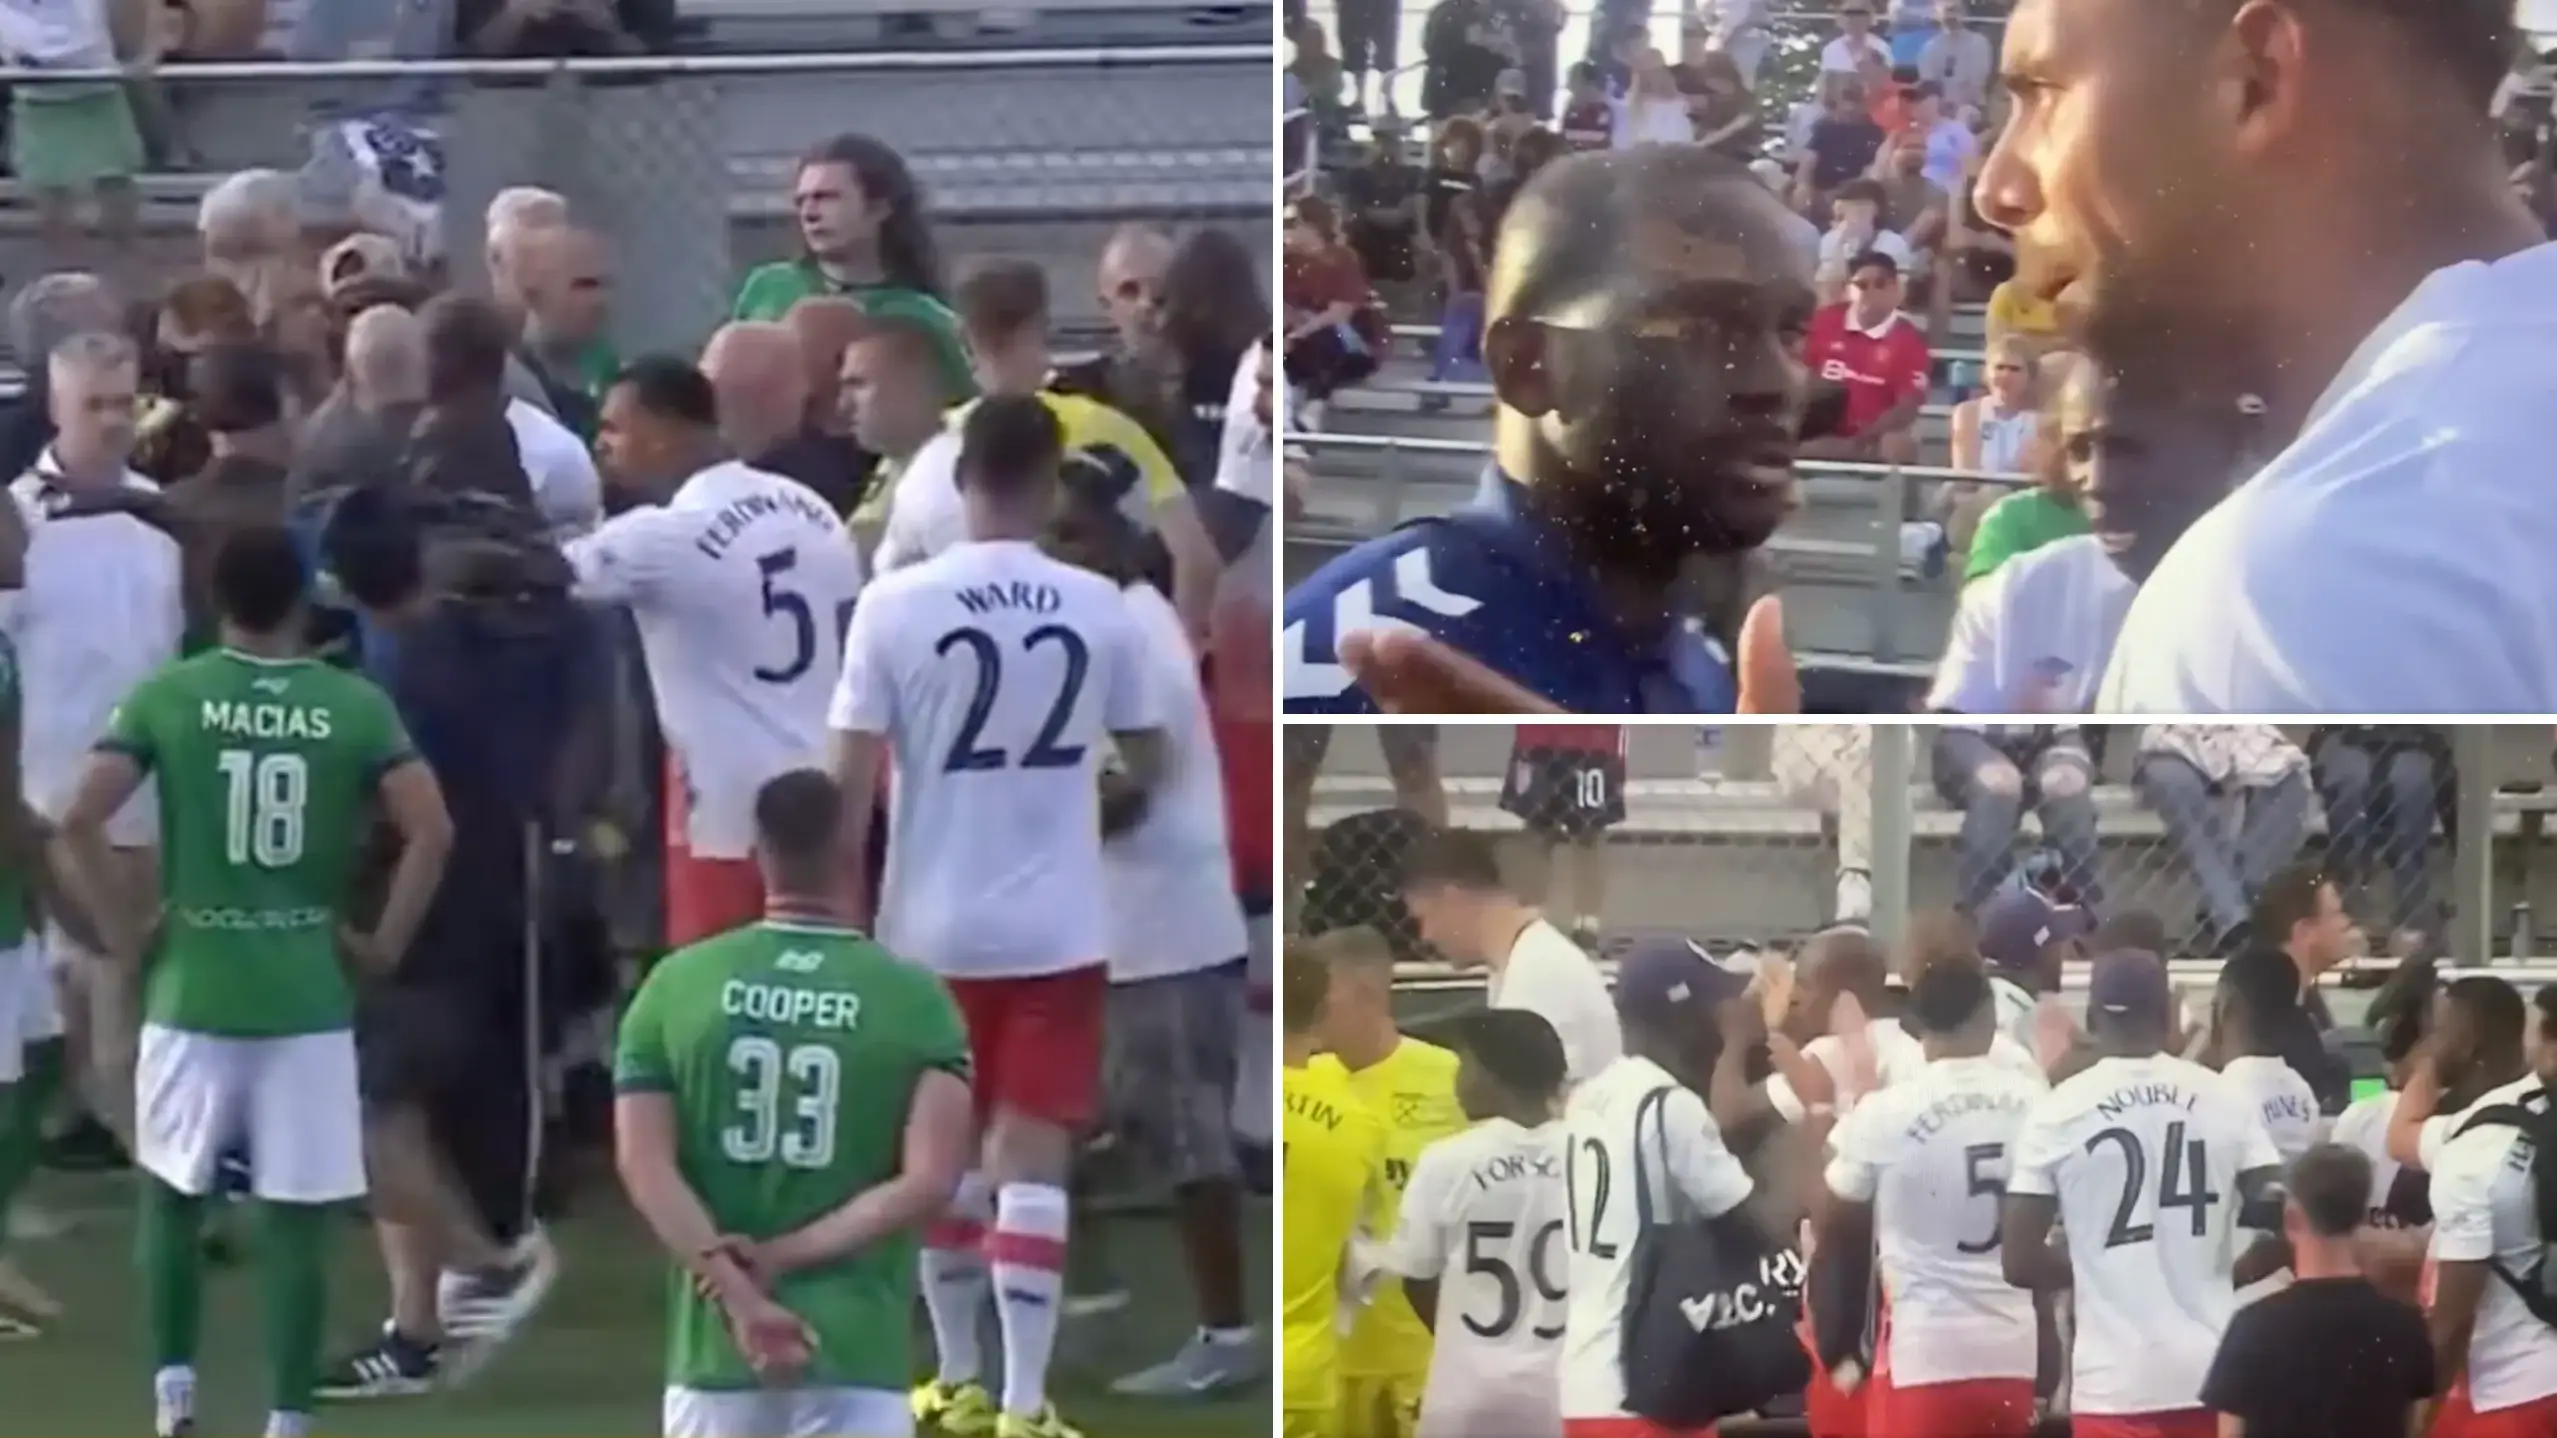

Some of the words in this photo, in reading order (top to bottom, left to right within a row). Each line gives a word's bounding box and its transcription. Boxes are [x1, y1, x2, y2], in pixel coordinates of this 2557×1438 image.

[754, 546, 816, 683] 5
[955, 580, 1062, 615] WARD
[201, 699, 332, 739] MACIAS
[934, 623, 1090, 774] 22
[217, 749, 307, 868] 18
[1574, 767, 1605, 809] 10
[721, 978, 862, 1029] COOPER
[721, 1034, 842, 1170] 33
[1956, 1141, 2008, 1254] 5
[2084, 1120, 2220, 1249] 24
